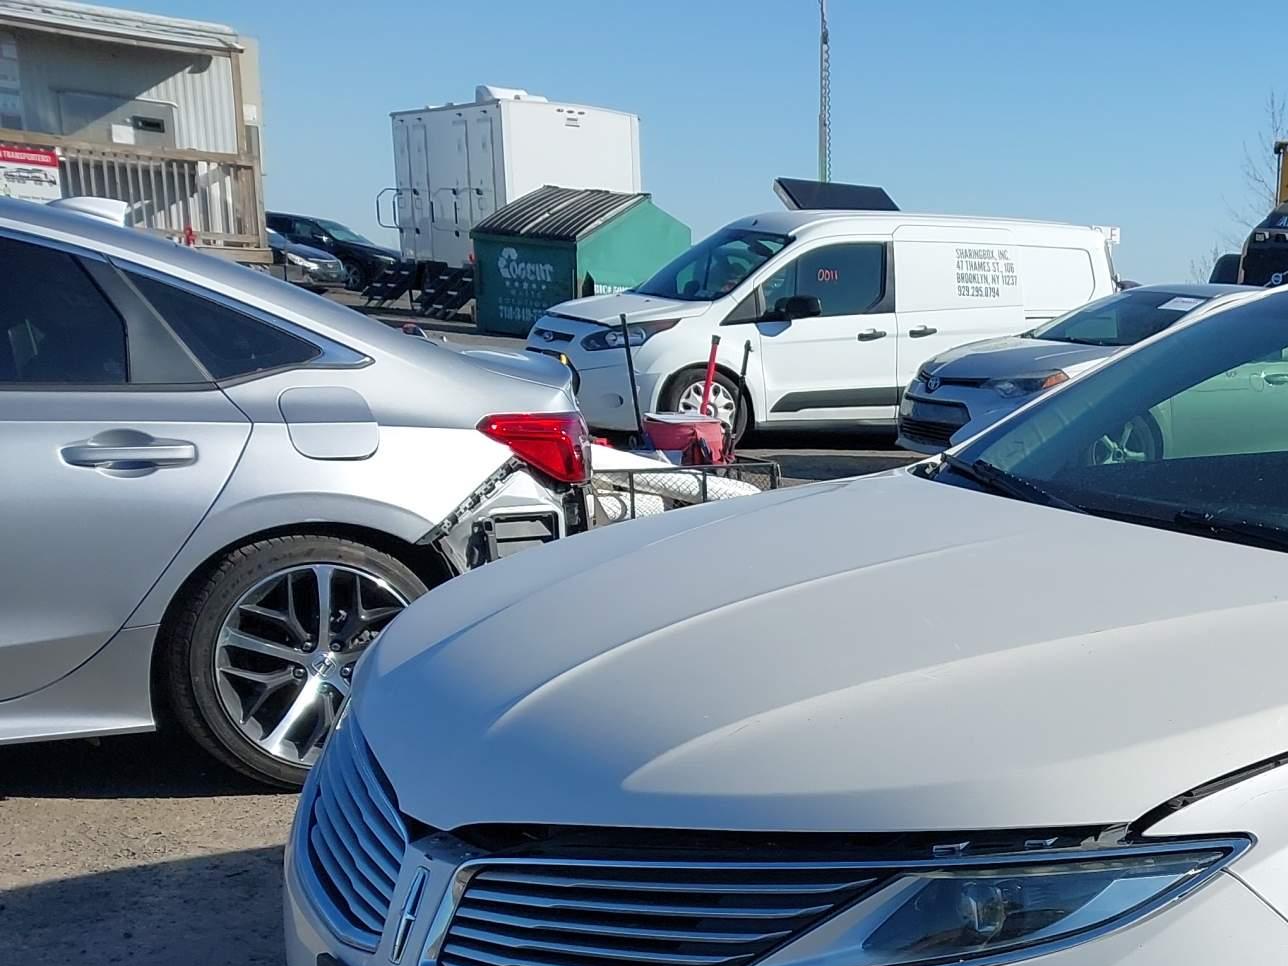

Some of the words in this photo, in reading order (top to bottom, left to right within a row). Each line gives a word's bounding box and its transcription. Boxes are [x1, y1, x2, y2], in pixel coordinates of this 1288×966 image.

[957, 260, 964, 271] 47
[965, 260, 991, 272] THAMES
[817, 268, 838, 281] 0011
[991, 274, 1000, 285] NY
[1001, 275, 1018, 287] 11237
